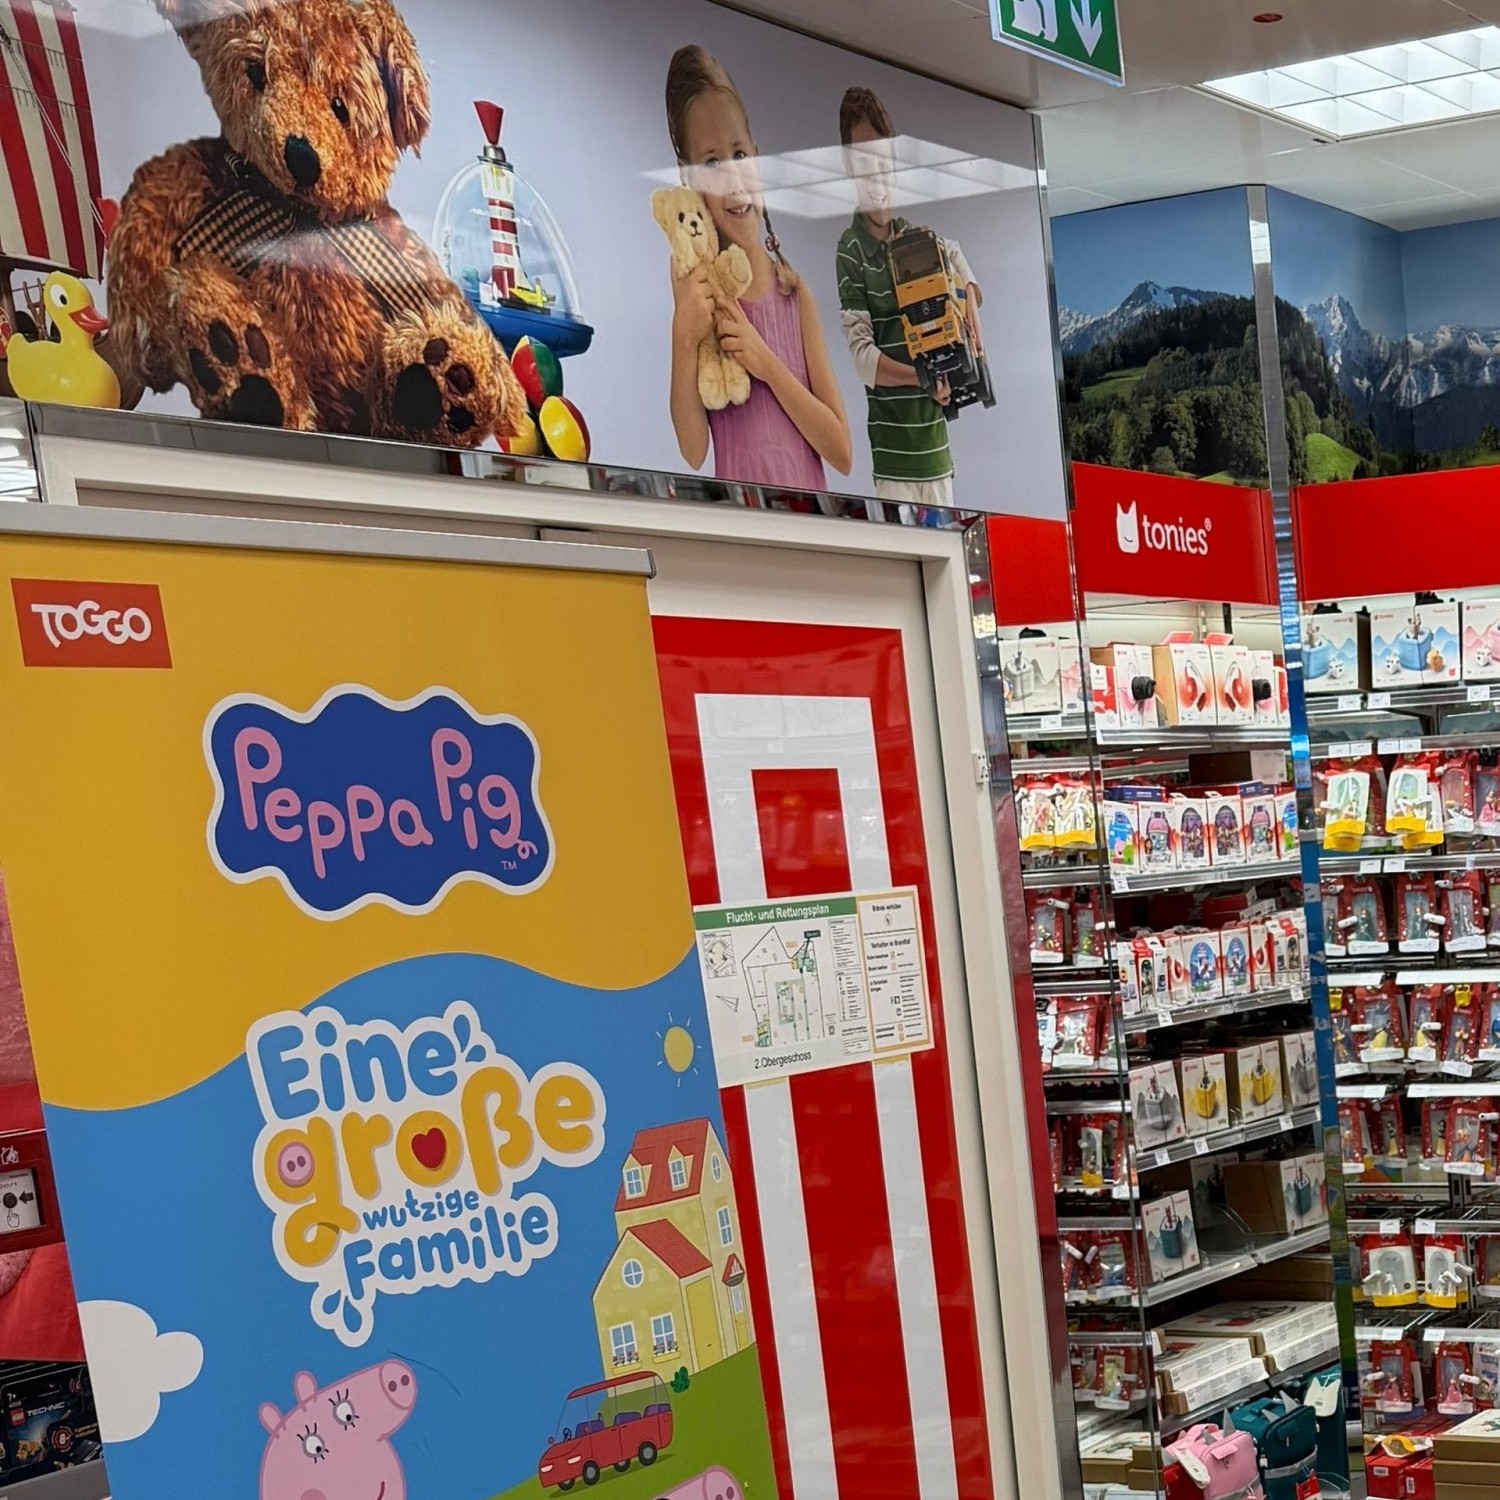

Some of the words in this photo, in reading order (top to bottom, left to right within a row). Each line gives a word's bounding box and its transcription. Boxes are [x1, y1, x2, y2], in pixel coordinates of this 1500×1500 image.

[32, 600, 152, 647] TOGGO
[233, 727, 433, 879] Peppa
[430, 727, 538, 858] Pig
[726, 909, 757, 924] Flucht-
[757, 908, 775, 921] und
[776, 904, 830, 921] Rettungsplan
[256, 1025, 462, 1121] Eine
[264, 1065, 596, 1268] große
[363, 1187, 480, 1231] wutzige
[342, 1201, 550, 1299] Familie
